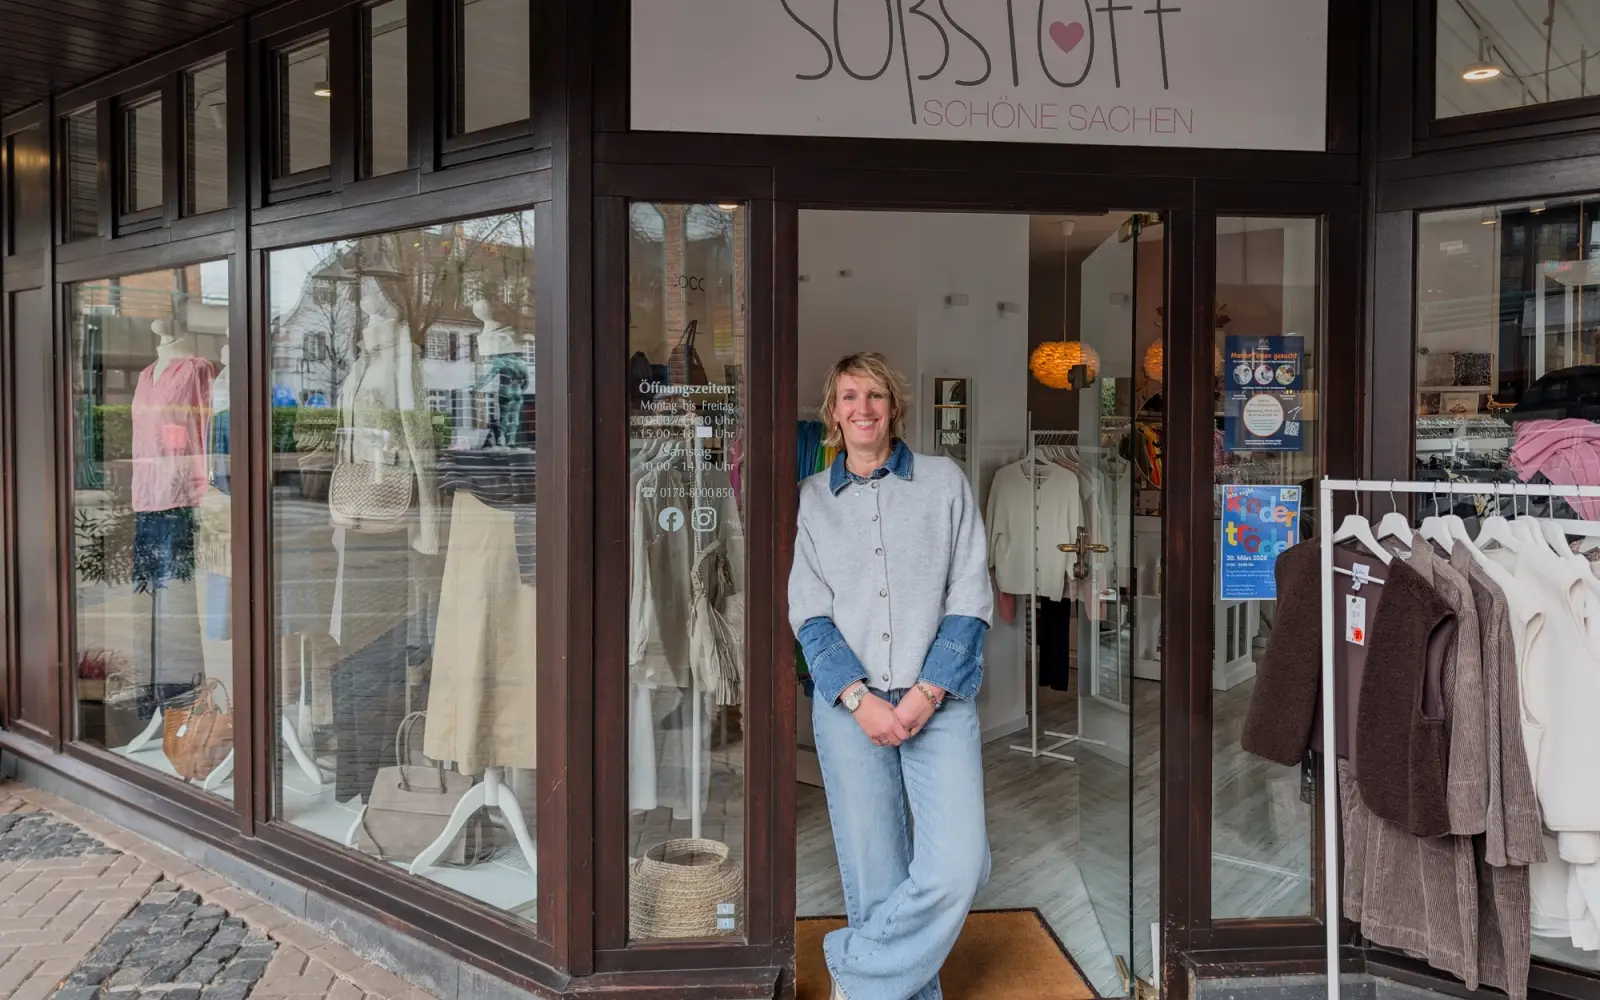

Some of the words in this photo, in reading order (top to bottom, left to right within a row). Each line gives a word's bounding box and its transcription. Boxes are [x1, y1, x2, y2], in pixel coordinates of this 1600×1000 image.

[923, 96, 1058, 131] SCHÖNE
[1067, 103, 1193, 135] SACHEN
[638, 379, 735, 397] Öffnungszeiten:
[640, 400, 678, 414] Montag
[683, 400, 697, 411] bis
[702, 400, 735, 414] Freitag
[714, 415, 735, 425] Uhr
[715, 429, 736, 439] Uhr
[663, 447, 712, 460] Samstag
[715, 461, 736, 472] Uhr
